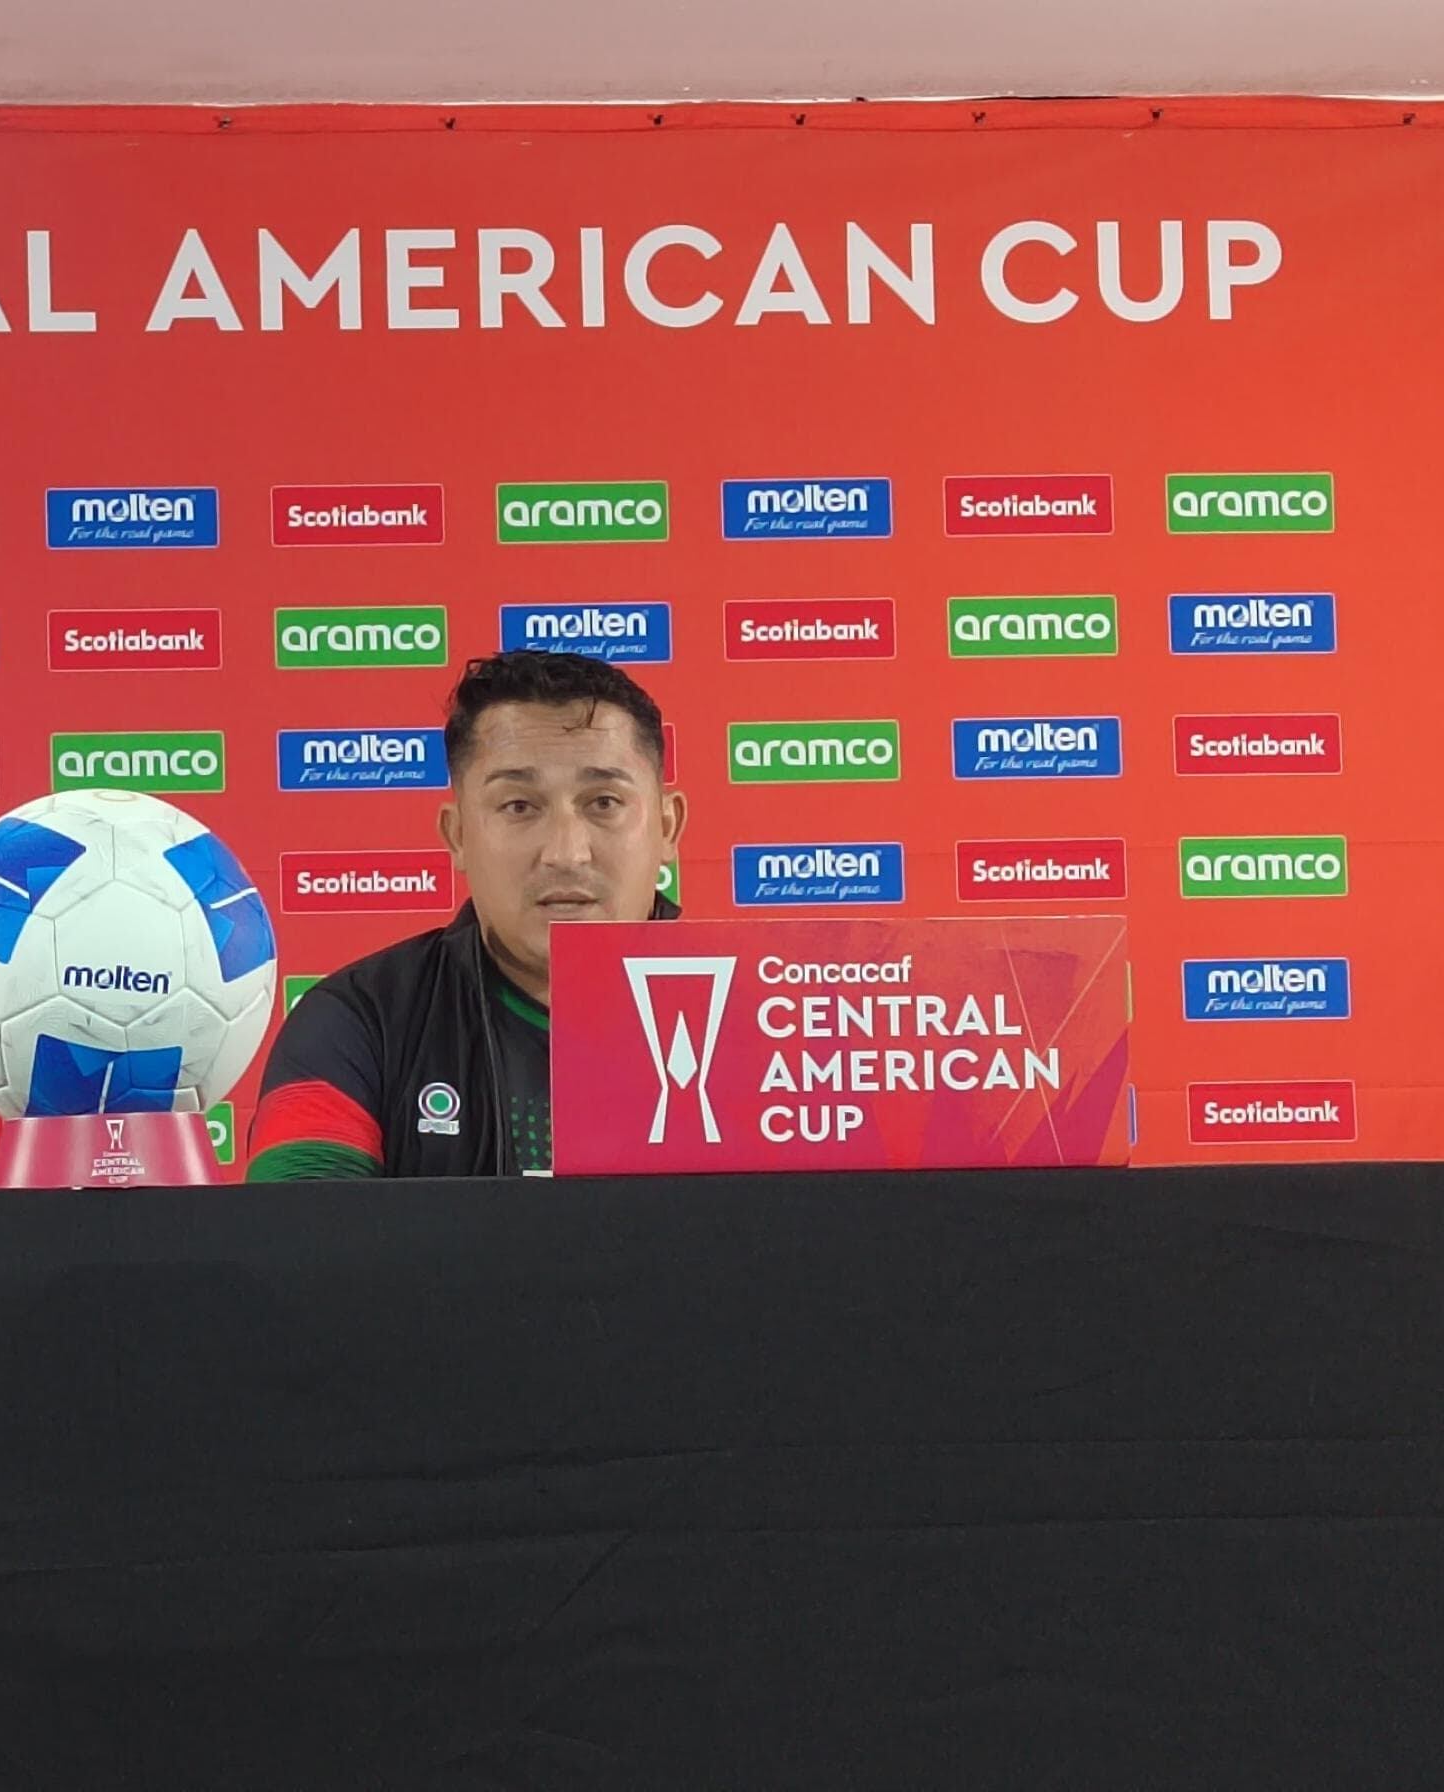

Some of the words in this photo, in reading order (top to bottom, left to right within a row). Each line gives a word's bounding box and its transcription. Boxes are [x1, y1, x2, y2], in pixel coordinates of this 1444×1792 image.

[146, 222, 935, 331] AMERICAN
[981, 221, 1281, 323] CUP
[73, 494, 193, 522] molten
[748, 485, 867, 512] molten
[961, 494, 1096, 517] Scotiabank
[1173, 491, 1327, 517] aramco
[289, 504, 426, 526] Scotiabank
[504, 500, 661, 526] aramco
[743, 517, 768, 531] For
[769, 516, 793, 529] the
[795, 516, 827, 528] real
[826, 519, 867, 533] game
[68, 527, 93, 541] For
[94, 526, 119, 540] the
[121, 526, 153, 539] real
[152, 529, 193, 543] game
[526, 609, 646, 637] molten
[1194, 600, 1311, 627] molten
[65, 629, 204, 651] Scotiabank
[282, 624, 440, 651] aramco
[741, 618, 878, 641] Scotiabank
[955, 614, 1110, 640] aramco
[1190, 632, 1213, 646] For
[1215, 631, 1238, 644] the
[1241, 631, 1272, 643] real
[1271, 634, 1311, 648] game
[605, 644, 646, 658] game
[305, 735, 424, 763] molten
[978, 724, 1097, 751] molten
[1191, 733, 1324, 756] Scotiabank
[58, 750, 217, 776] aramco
[735, 739, 892, 766] aramco
[973, 756, 998, 770] For
[999, 755, 1023, 768] the
[1025, 755, 1057, 767] real
[1056, 758, 1097, 772] game
[300, 768, 325, 782] For
[326, 767, 350, 781] the
[352, 767, 384, 780] real
[383, 770, 424, 784] game
[759, 850, 878, 878] molten
[973, 858, 1109, 882] Scotiabank
[1186, 854, 1340, 881] aramco
[298, 870, 436, 893] Scotiabank
[754, 883, 779, 897] For
[780, 882, 804, 896] the
[806, 882, 838, 895] real
[837, 885, 878, 899] game
[64, 965, 169, 994] molten
[759, 955, 911, 983] Concacaf
[1209, 965, 1325, 993] molten
[758, 995, 1021, 1037] CENTRAL
[1205, 998, 1228, 1012] For
[1229, 997, 1253, 1011] the
[1255, 997, 1286, 1010] real
[1285, 1000, 1325, 1014] game
[761, 1048, 1059, 1092] AMERICAN
[761, 1106, 863, 1142] CUP
[1205, 1101, 1338, 1124] Scotiabank
